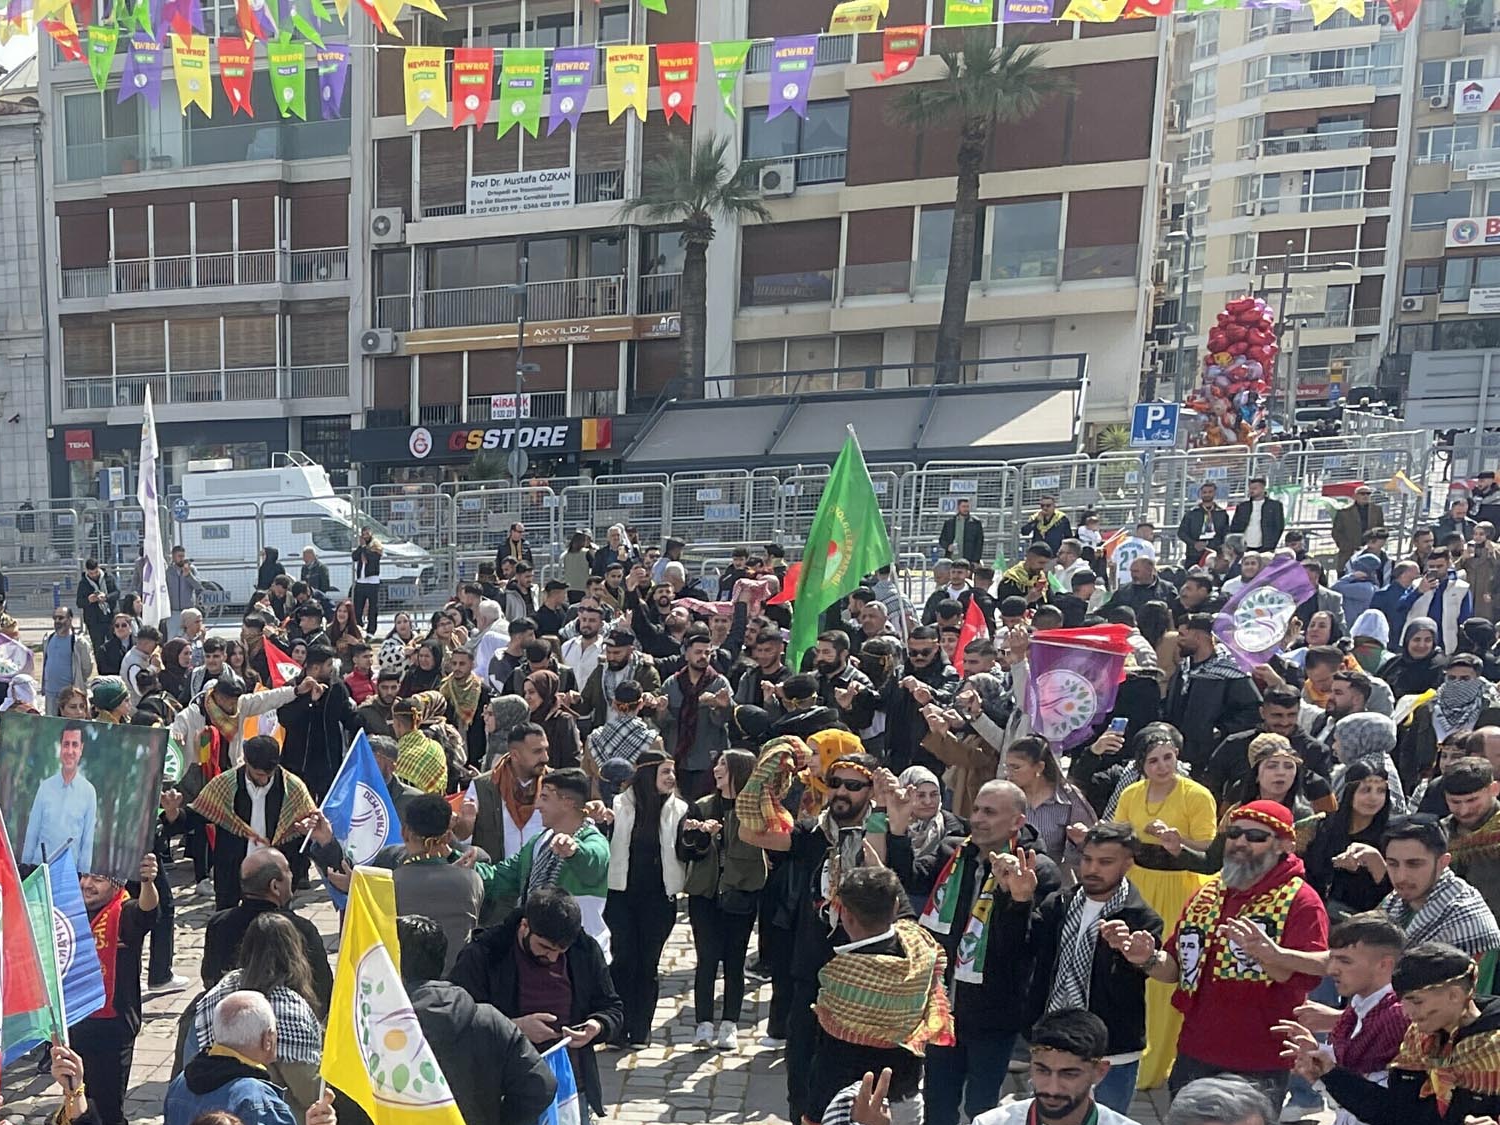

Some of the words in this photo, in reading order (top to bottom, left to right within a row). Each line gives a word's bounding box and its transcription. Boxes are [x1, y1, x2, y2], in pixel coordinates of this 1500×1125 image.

[176, 47, 206, 57] NEWROZ
[776, 46, 814, 58] NEWROZ
[220, 55, 250, 65] NEWROZ
[609, 54, 645, 63] NEWROZ
[659, 58, 694, 68] NEWROZ
[408, 60, 440, 69] NEWROZ
[455, 62, 489, 71] NEWROZ
[555, 62, 590, 72] NEWROZ
[505, 65, 540, 75] NEWROZ
[471, 179, 488, 188] Prof
[504, 176, 537, 186] Mustafa
[539, 172, 571, 182] ÖZKAN
[534, 325, 590, 336] AKYILDIZ
[1146, 405, 1166, 428] P
[952, 482, 975, 491] POLİS
[1035, 476, 1058, 488] POLİS
[622, 493, 642, 503] POLİS
[203, 527, 228, 538] POLİS
[391, 521, 417, 534] POLİS
[391, 585, 417, 598] POLİS
[203, 591, 231, 604] POLİS
